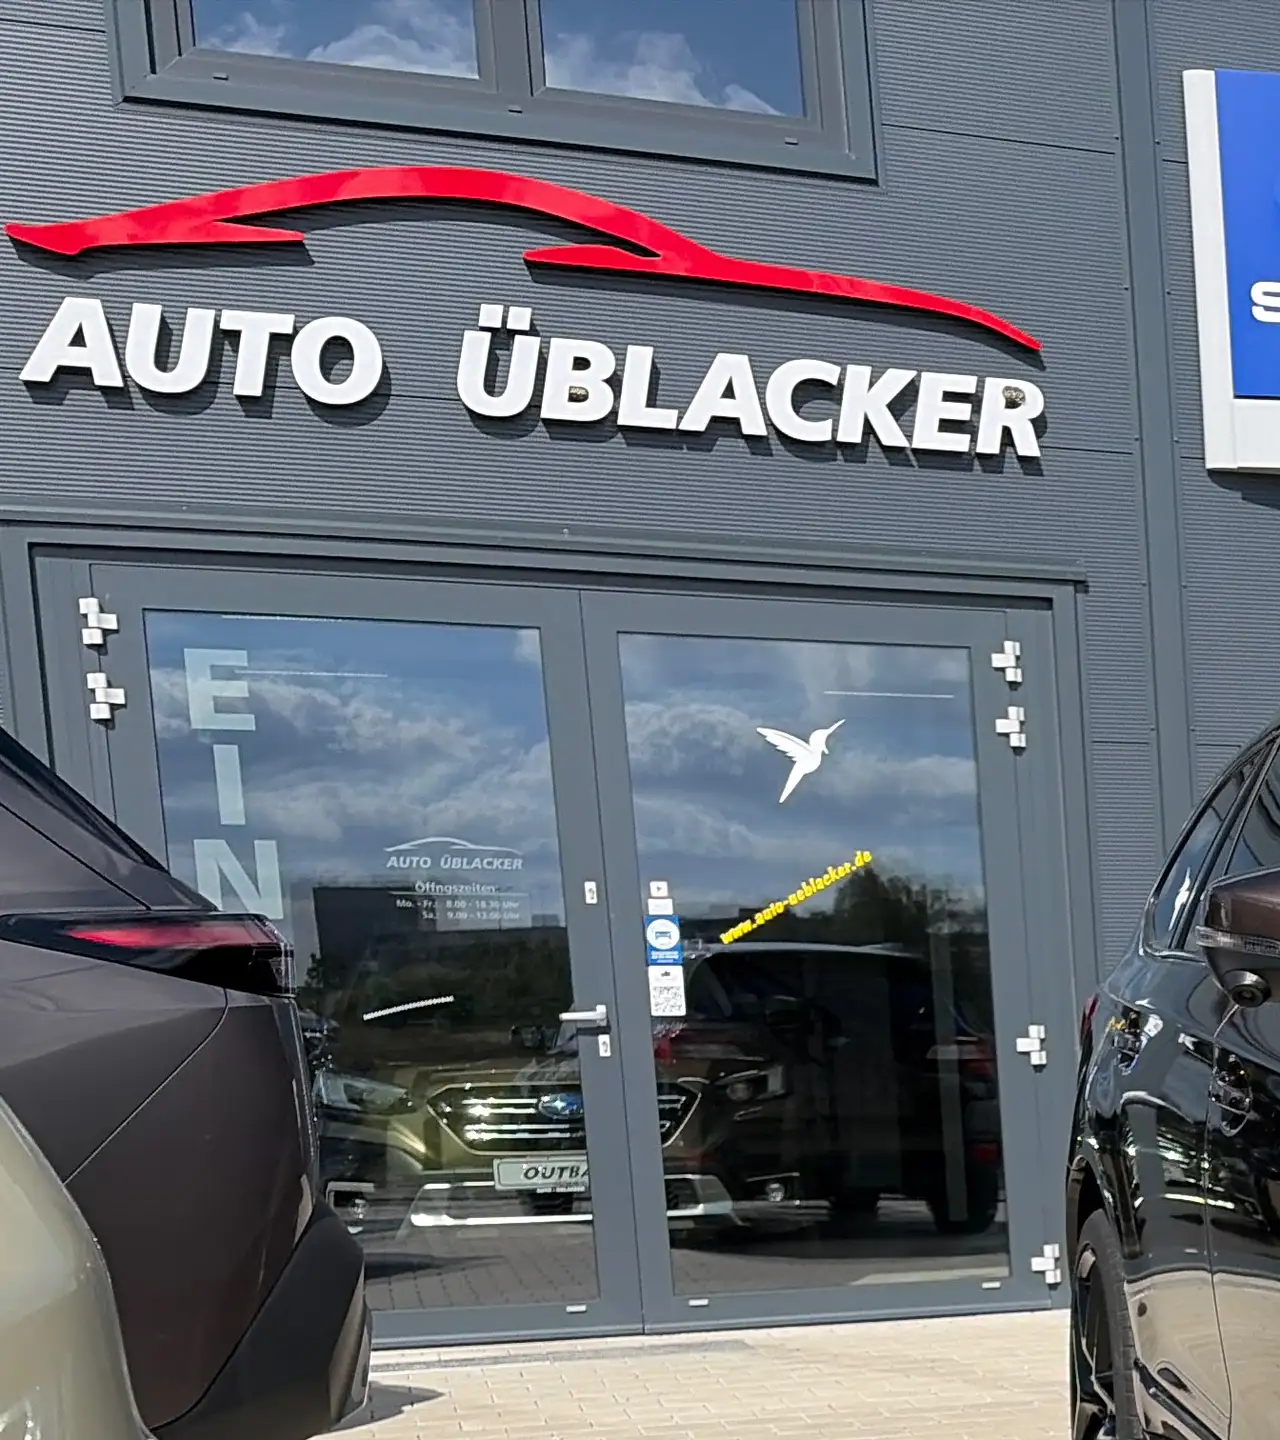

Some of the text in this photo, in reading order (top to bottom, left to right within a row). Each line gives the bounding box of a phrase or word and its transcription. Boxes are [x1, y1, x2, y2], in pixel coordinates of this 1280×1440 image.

[19, 295, 1044, 457] AUTO ÜBLACKER
[386, 854, 524, 870] AUTO ÜBLACKER
[719, 850, 872, 945] www.auto-ueblacker.de
